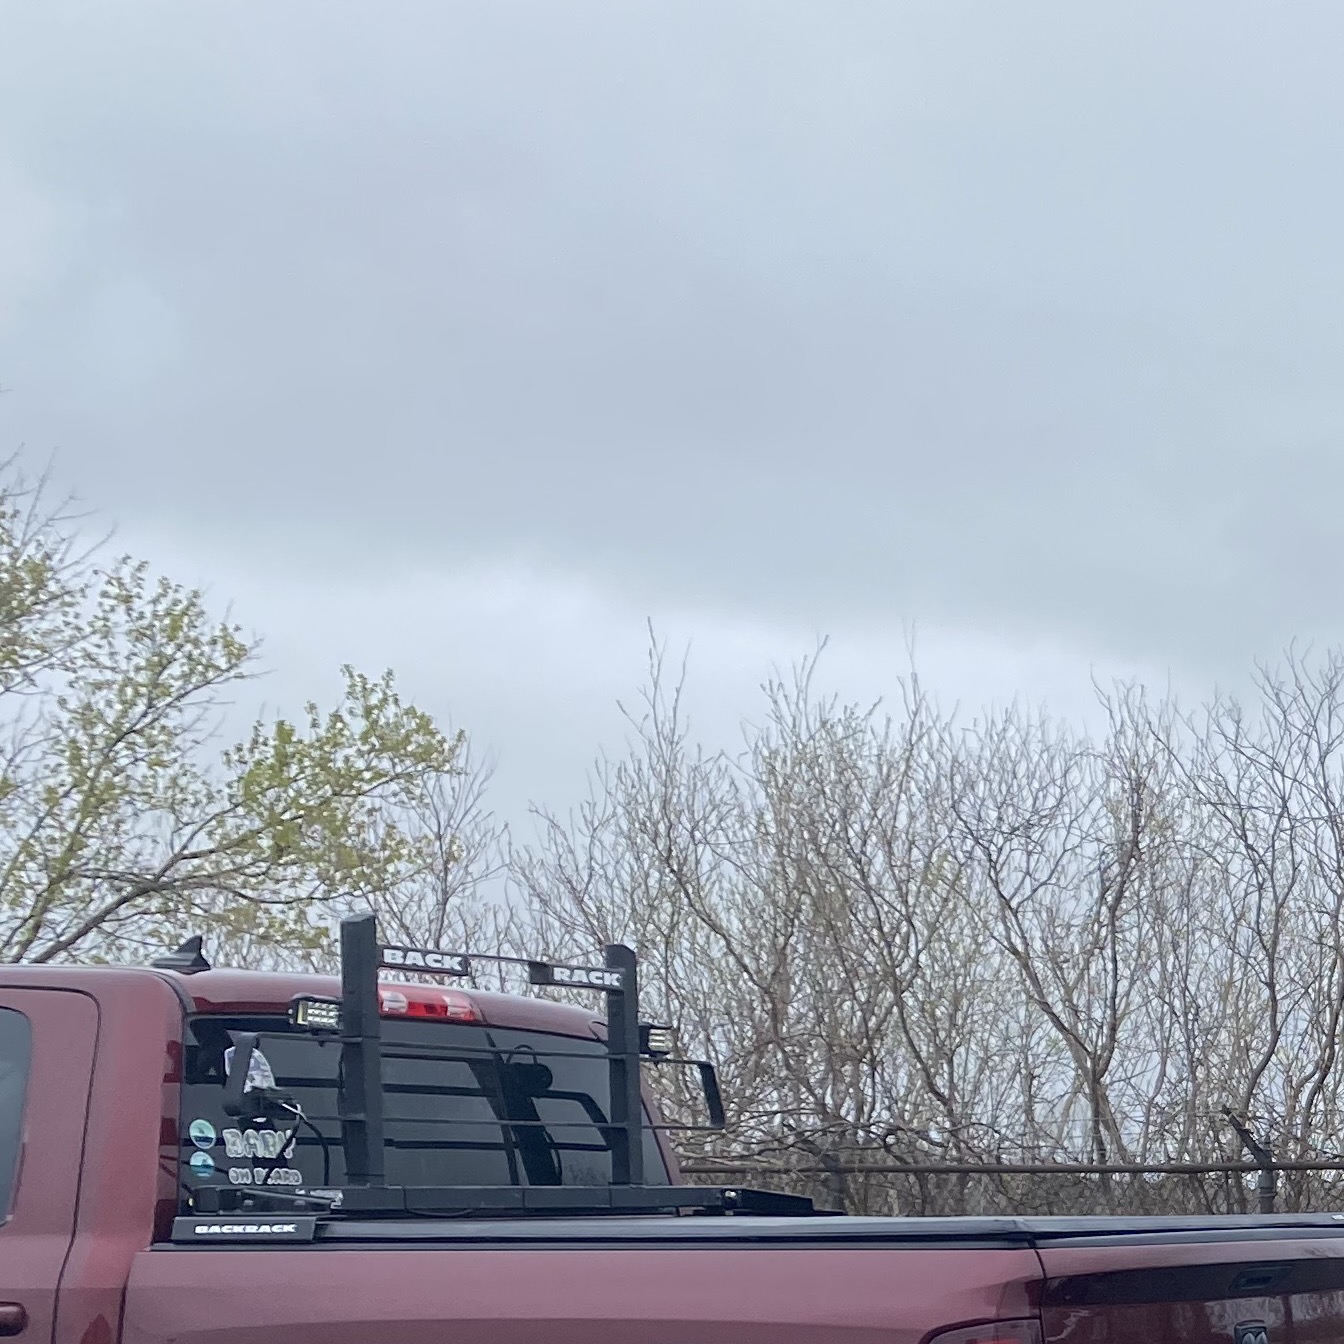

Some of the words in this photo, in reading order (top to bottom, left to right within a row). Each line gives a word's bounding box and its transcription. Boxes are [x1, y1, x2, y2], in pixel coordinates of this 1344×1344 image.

[383, 948, 463, 971] BACK
[552, 967, 621, 987] RACK
[194, 1224, 298, 1234] BACKRACK
